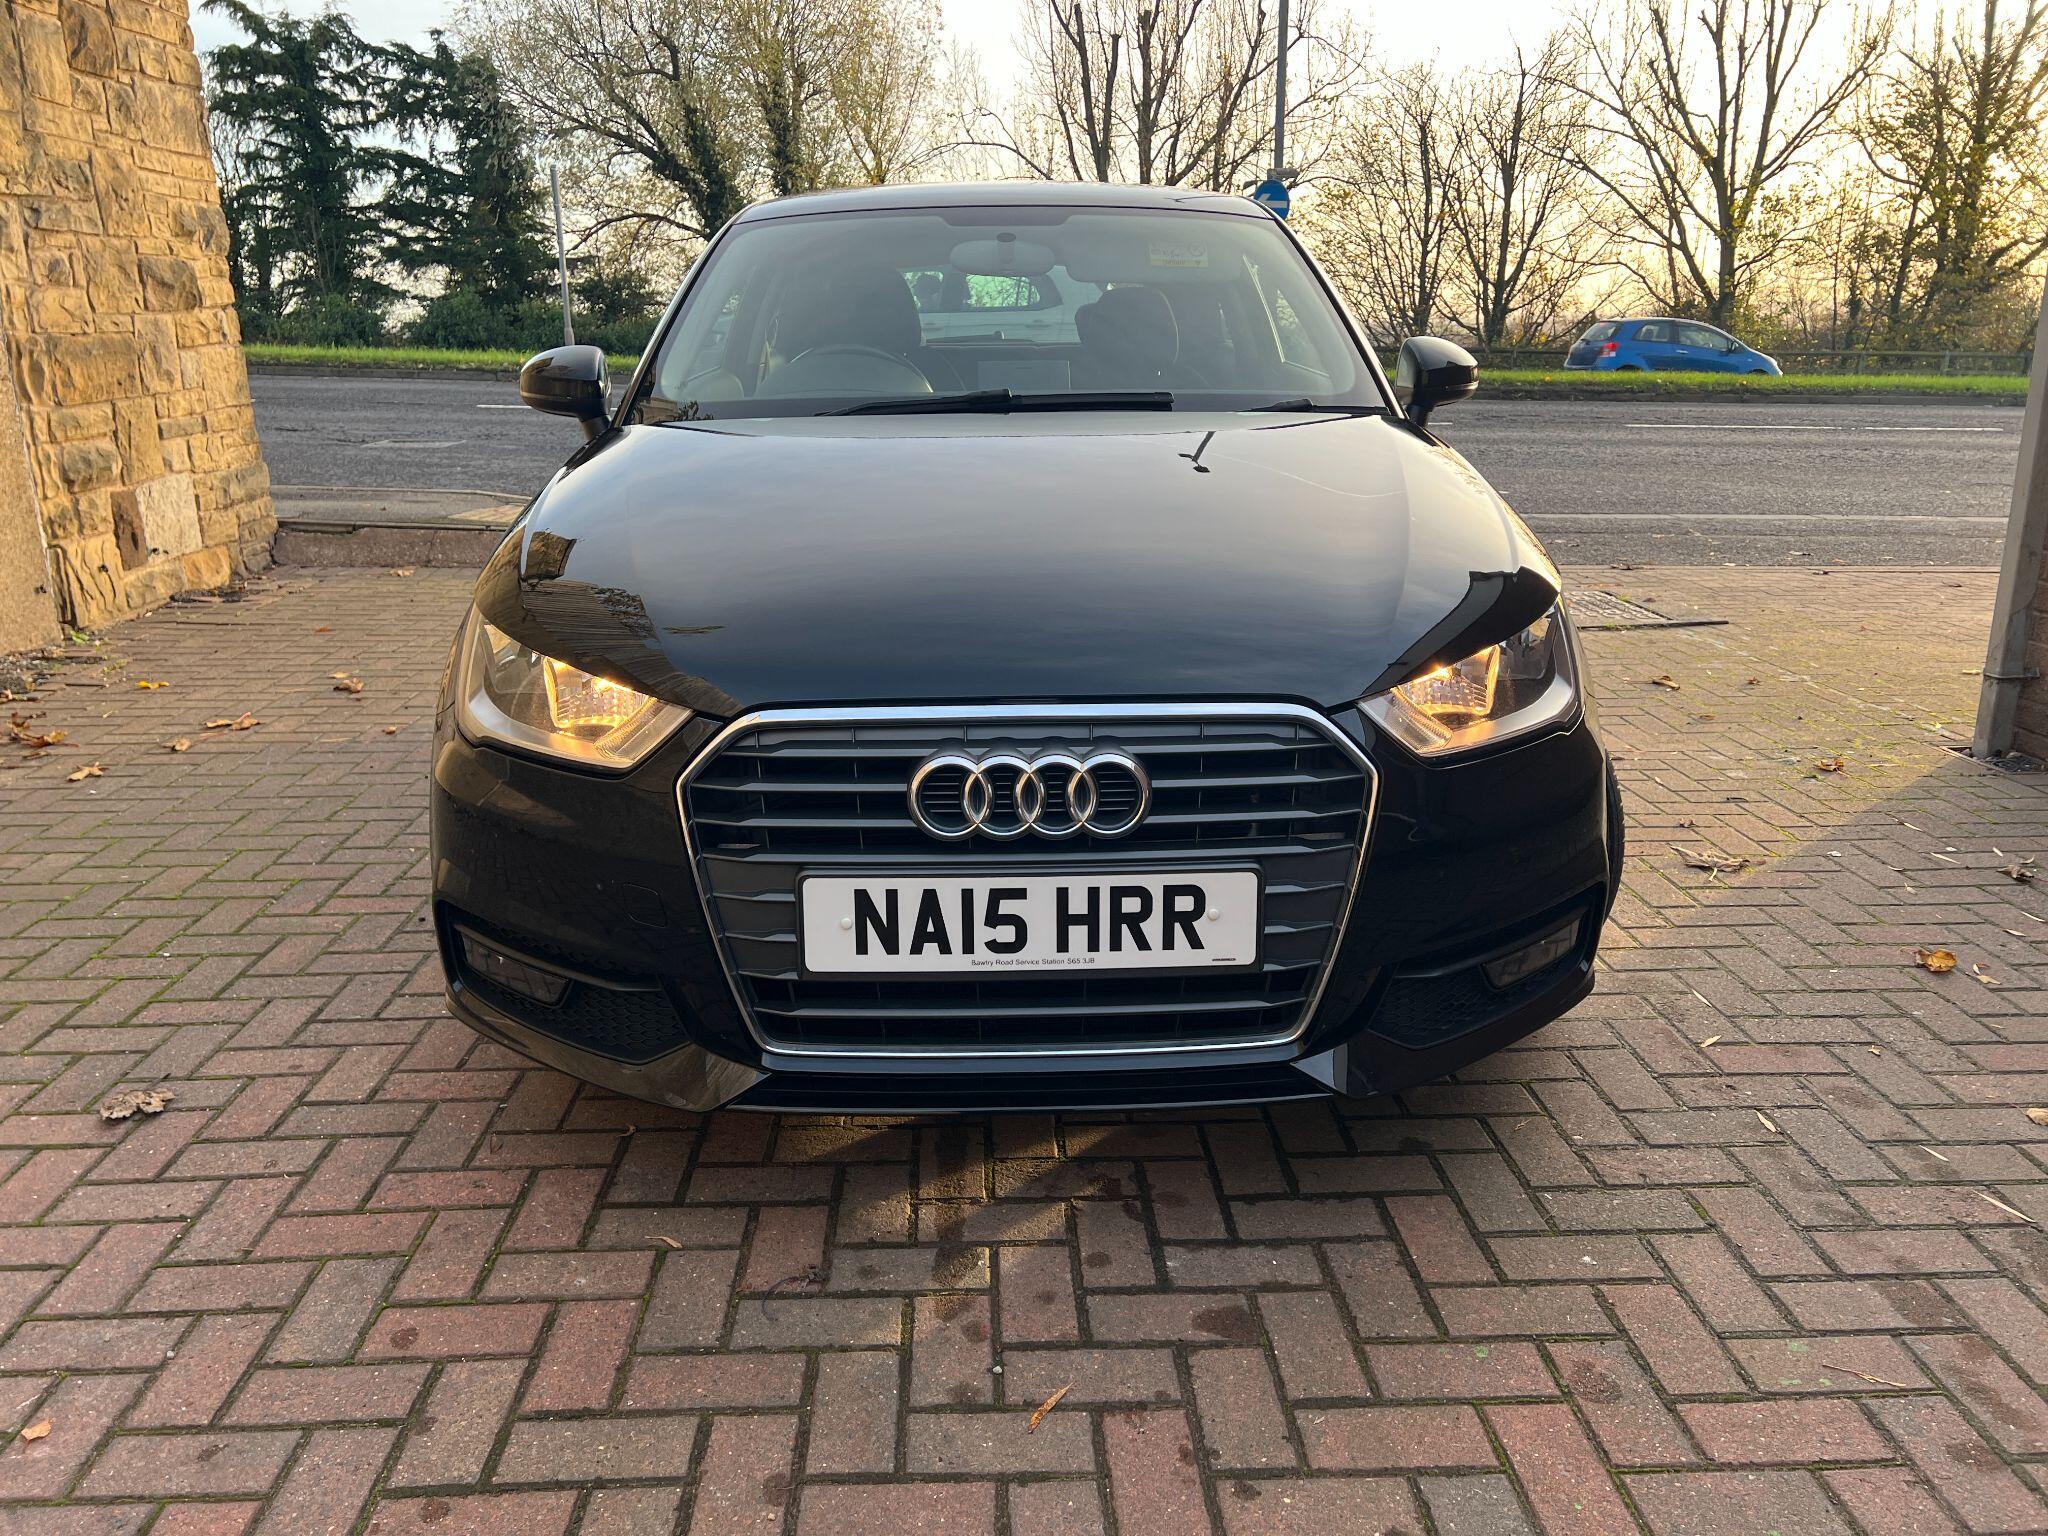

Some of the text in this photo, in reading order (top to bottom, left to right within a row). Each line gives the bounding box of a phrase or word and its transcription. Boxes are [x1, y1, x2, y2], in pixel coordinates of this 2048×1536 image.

[854, 884, 1206, 955] NA15 HRR
[971, 959, 994, 968] Bawtry
[1015, 958, 1040, 966] Service
[1067, 957, 1081, 965] S65
